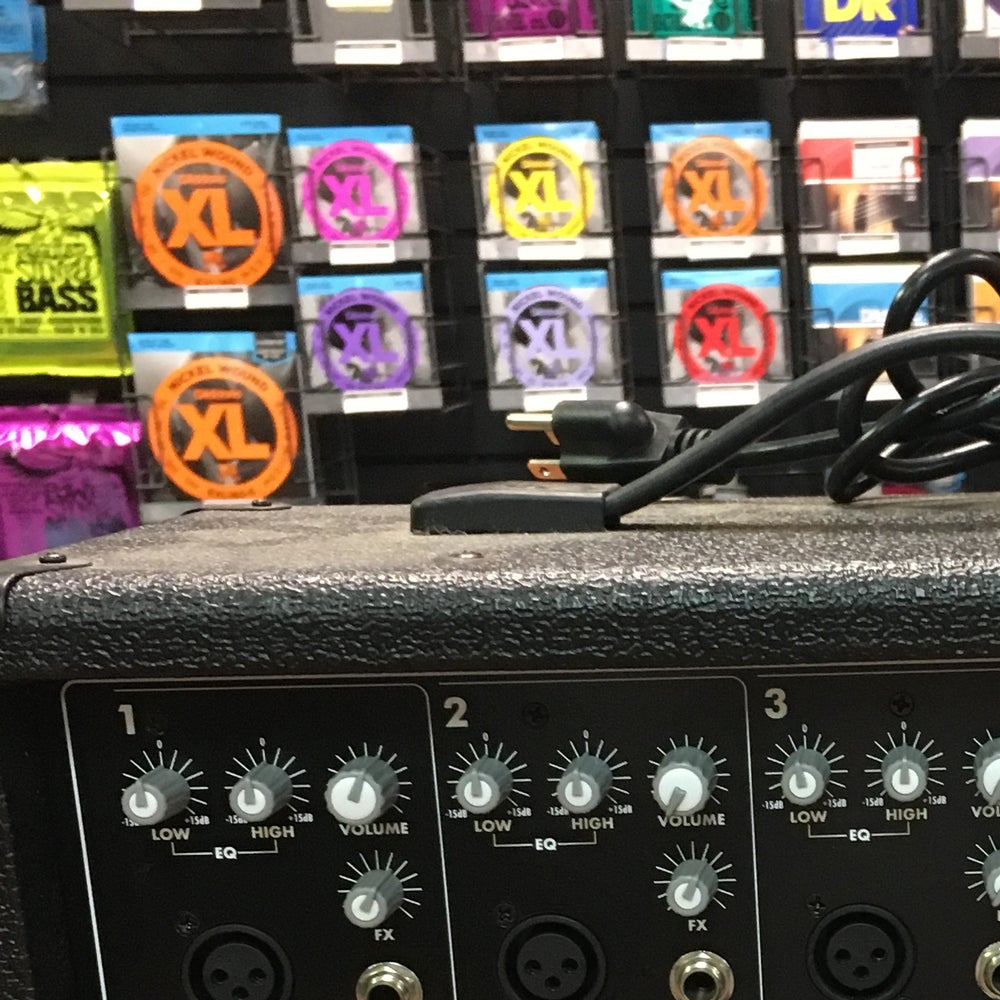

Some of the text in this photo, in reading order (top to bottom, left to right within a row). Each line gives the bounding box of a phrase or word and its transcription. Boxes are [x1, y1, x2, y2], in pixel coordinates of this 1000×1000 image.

[323, 174, 389, 218] XL
[509, 170, 573, 213] XL
[684, 169, 745, 213] XL
[162, 187, 256, 248] XL
[16, 277, 98, 313] BASS
[333, 322, 399, 364] XL
[519, 318, 581, 358] XL
[694, 316, 757, 358] XL
[178, 402, 271, 462] XL
[764, 688, 788, 719] 3
[117, 704, 136, 735] 1
[443, 697, 469, 728] 2
[225, 814, 248, 824] -15
[658, 813, 726, 827] VOLUME
[789, 810, 828, 824] LOW
[886, 808, 928, 821] HIGH
[121, 817, 139, 827] -15
[338, 822, 409, 836] VOLUME
[474, 819, 512, 833] LOW
[571, 817, 614, 830] HIGH
[151, 827, 190, 841] LOW
[251, 825, 295, 839] HIGH
[849, 828, 871, 842] EQ
[534, 838, 557, 851] EQ
[214, 847, 237, 860] EQ
[687, 919, 708, 932] FX
[373, 928, 396, 942] FX
